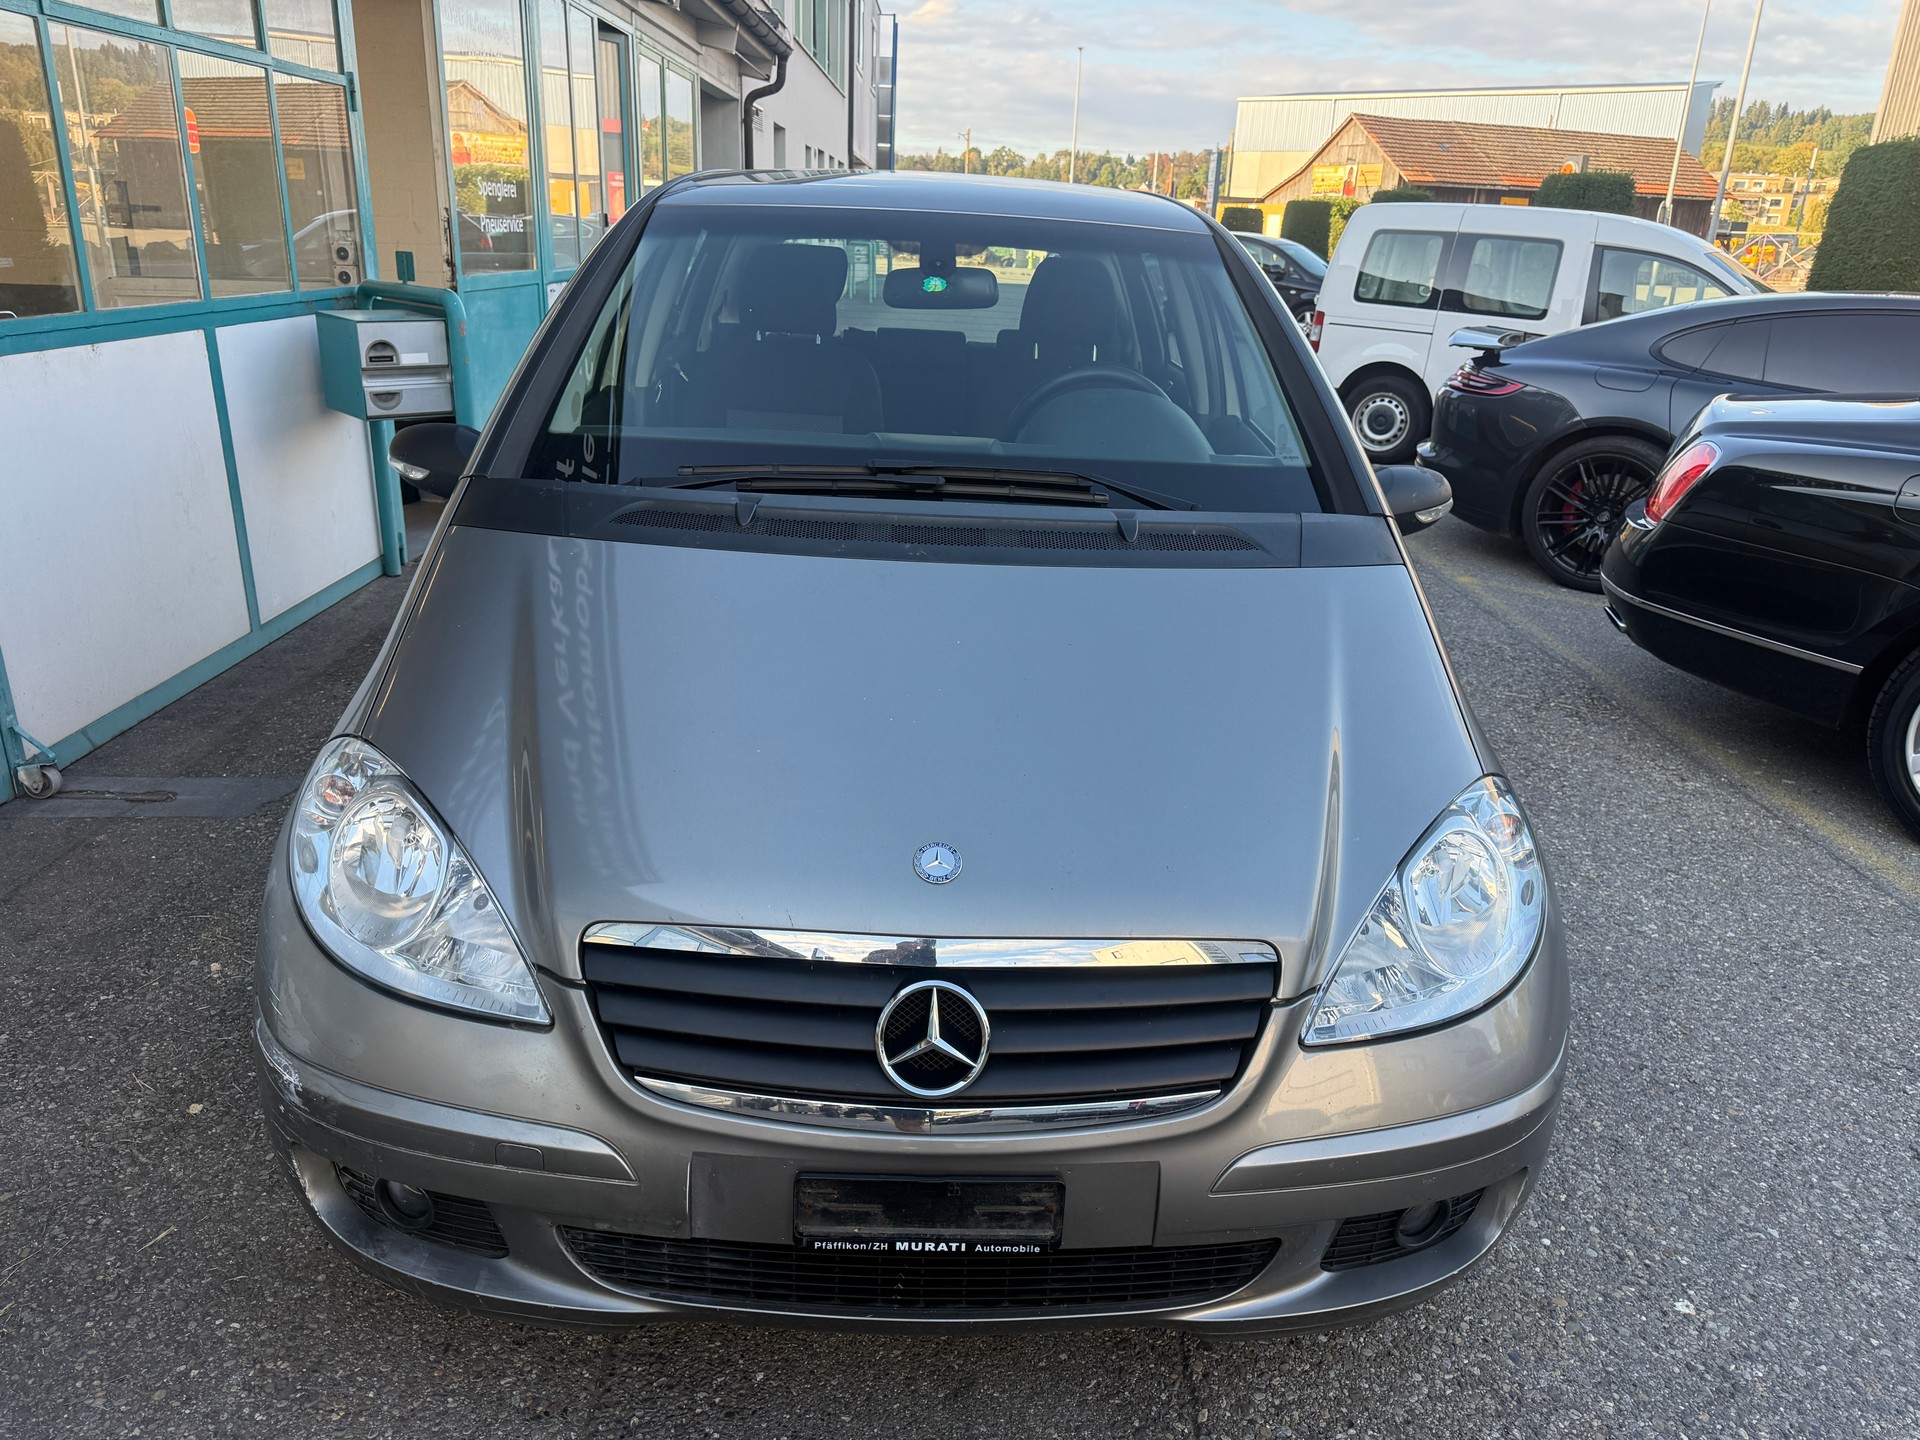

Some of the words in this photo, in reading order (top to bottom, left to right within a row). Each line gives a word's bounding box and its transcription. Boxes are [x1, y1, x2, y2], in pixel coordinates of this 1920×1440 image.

[477, 176, 517, 202] Spenglerei
[480, 214, 524, 233] Pneuservice
[814, 1241, 888, 1251] Pfäffikon/ZH
[895, 1242, 967, 1252] MURATI
[974, 1243, 1041, 1253] Automobile
